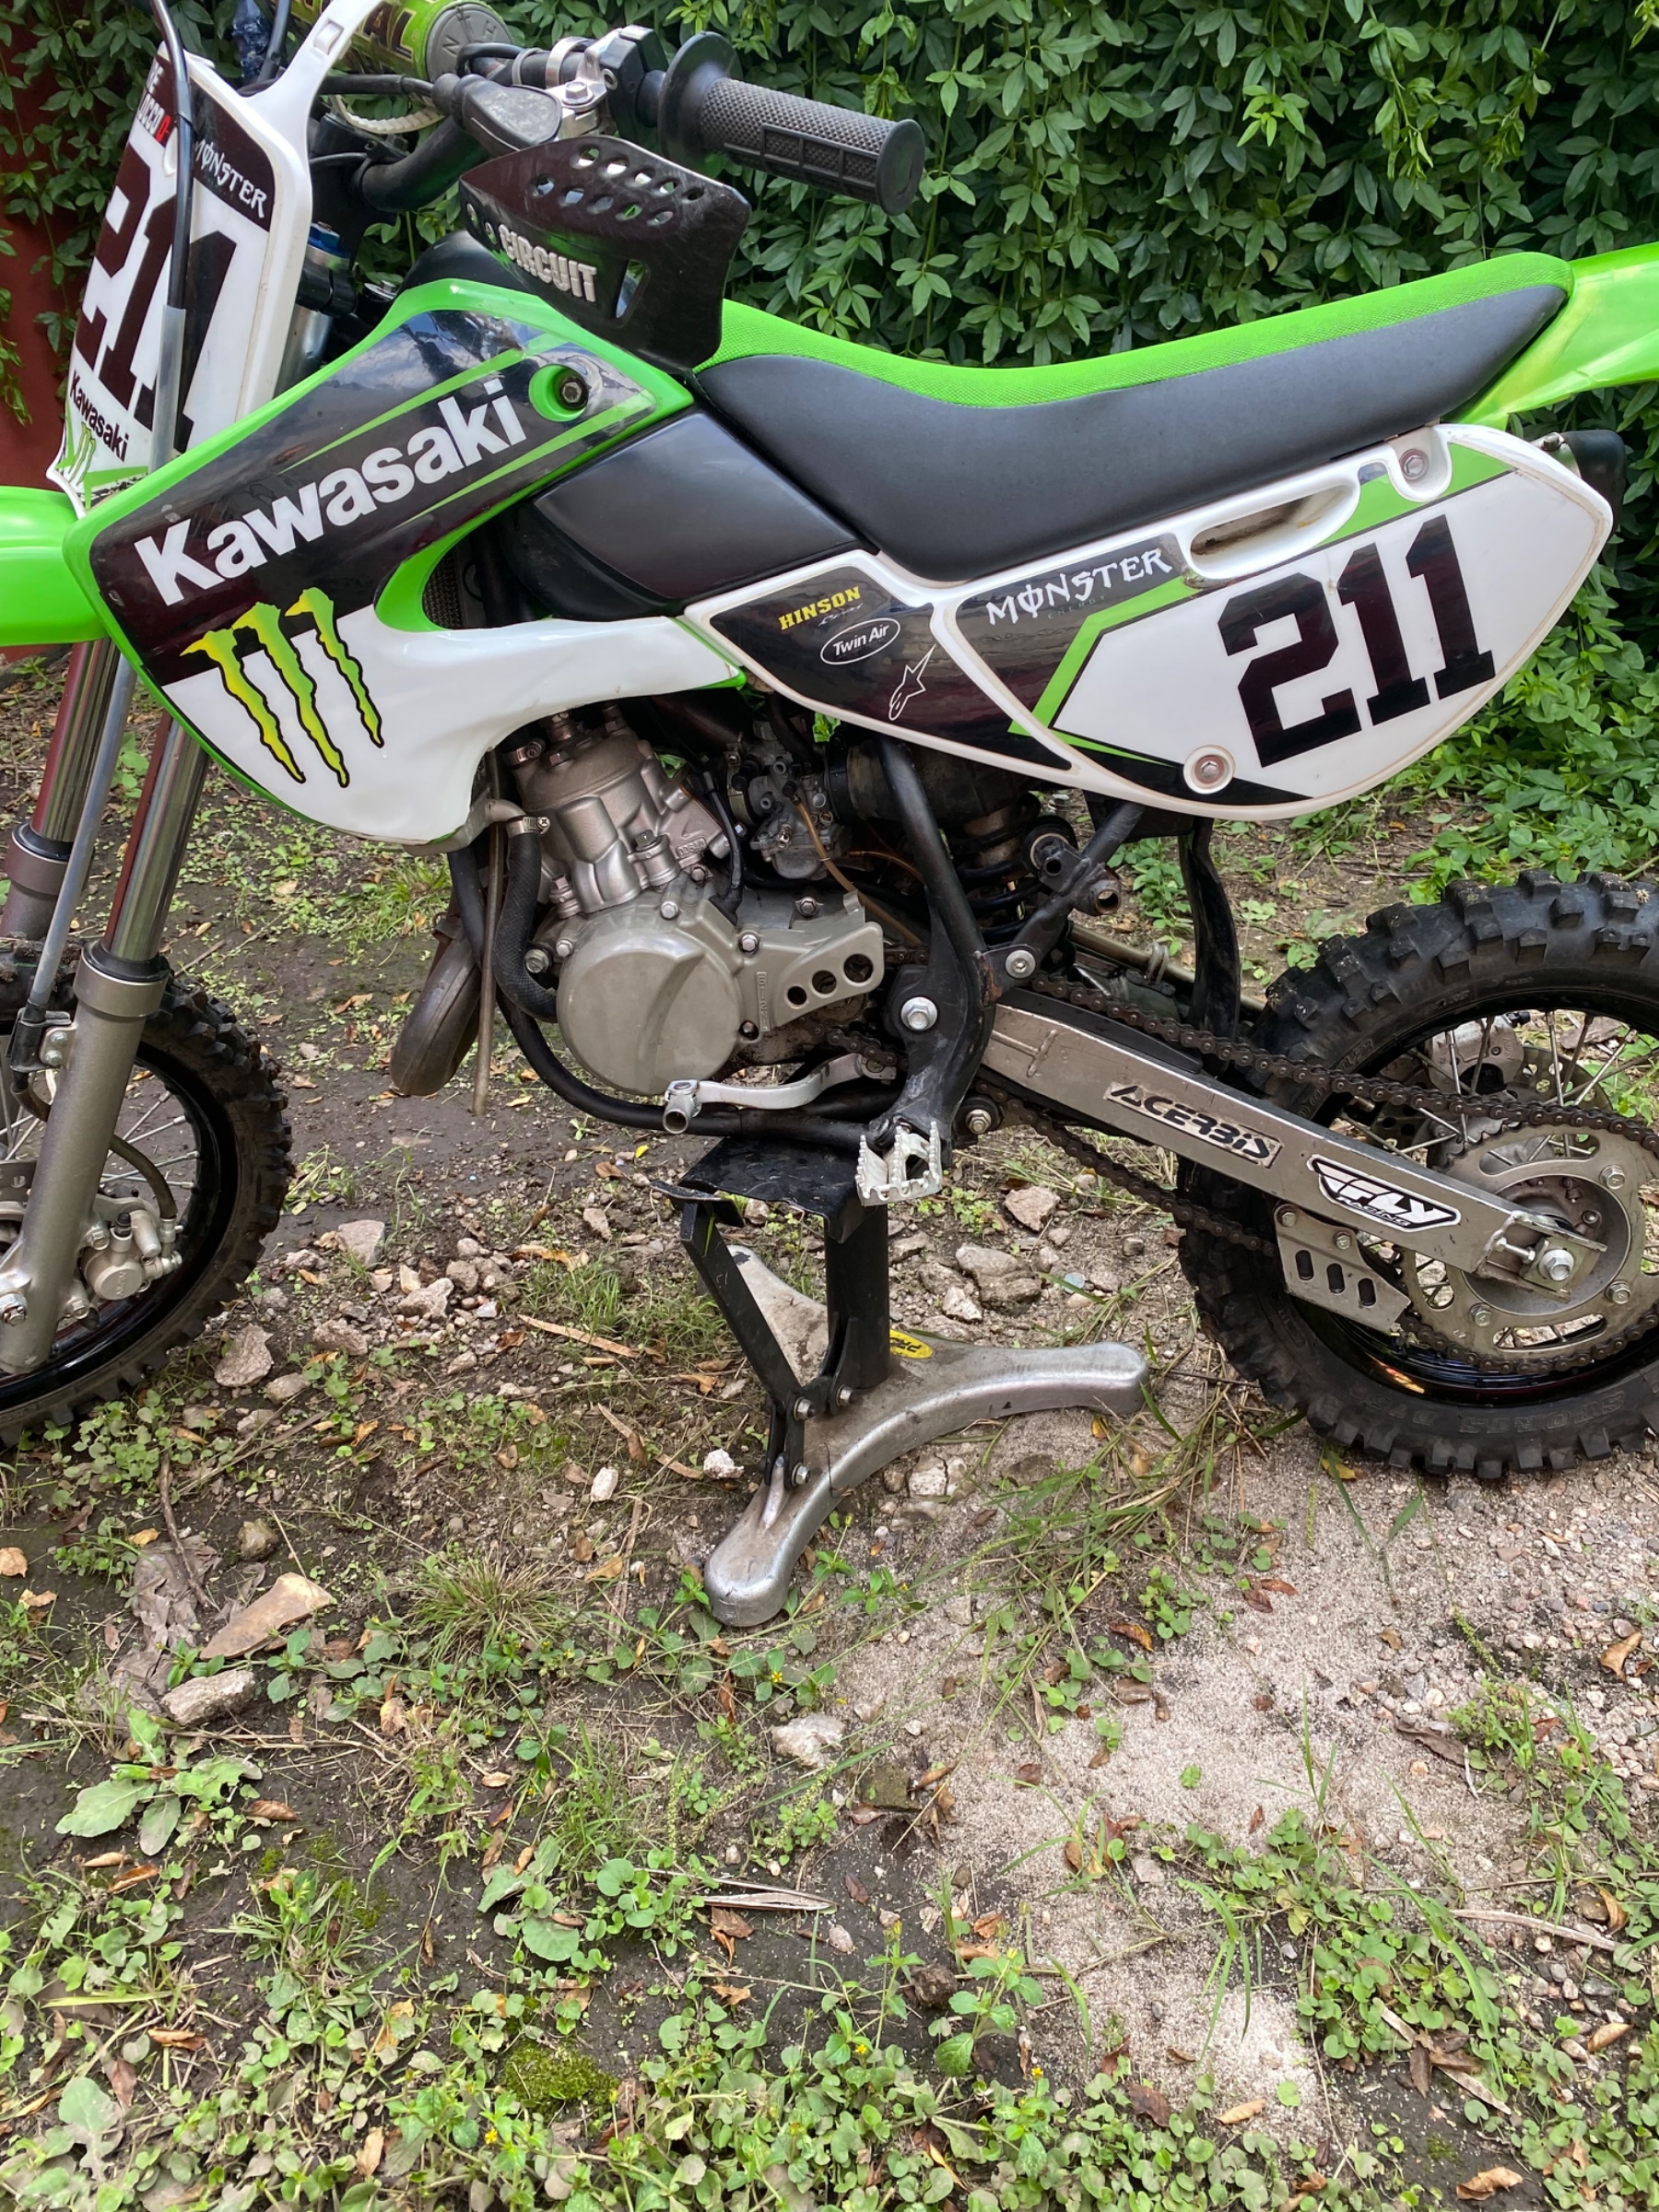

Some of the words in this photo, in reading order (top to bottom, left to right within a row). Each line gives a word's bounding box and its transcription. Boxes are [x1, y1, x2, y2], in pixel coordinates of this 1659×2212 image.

[499, 223, 597, 302] CIRCUIT
[70, 369, 129, 462] Kawasaki
[134, 379, 527, 606] Kawasaki
[778, 585, 862, 630] HINSON
[832, 634, 866, 656] Twin
[868, 624, 889, 642] Air
[1218, 513, 1496, 768] 211
[1111, 1085, 1270, 1159] ACERBIS
[1325, 1167, 1454, 1224] FLY
[1336, 1196, 1412, 1227] RACING
